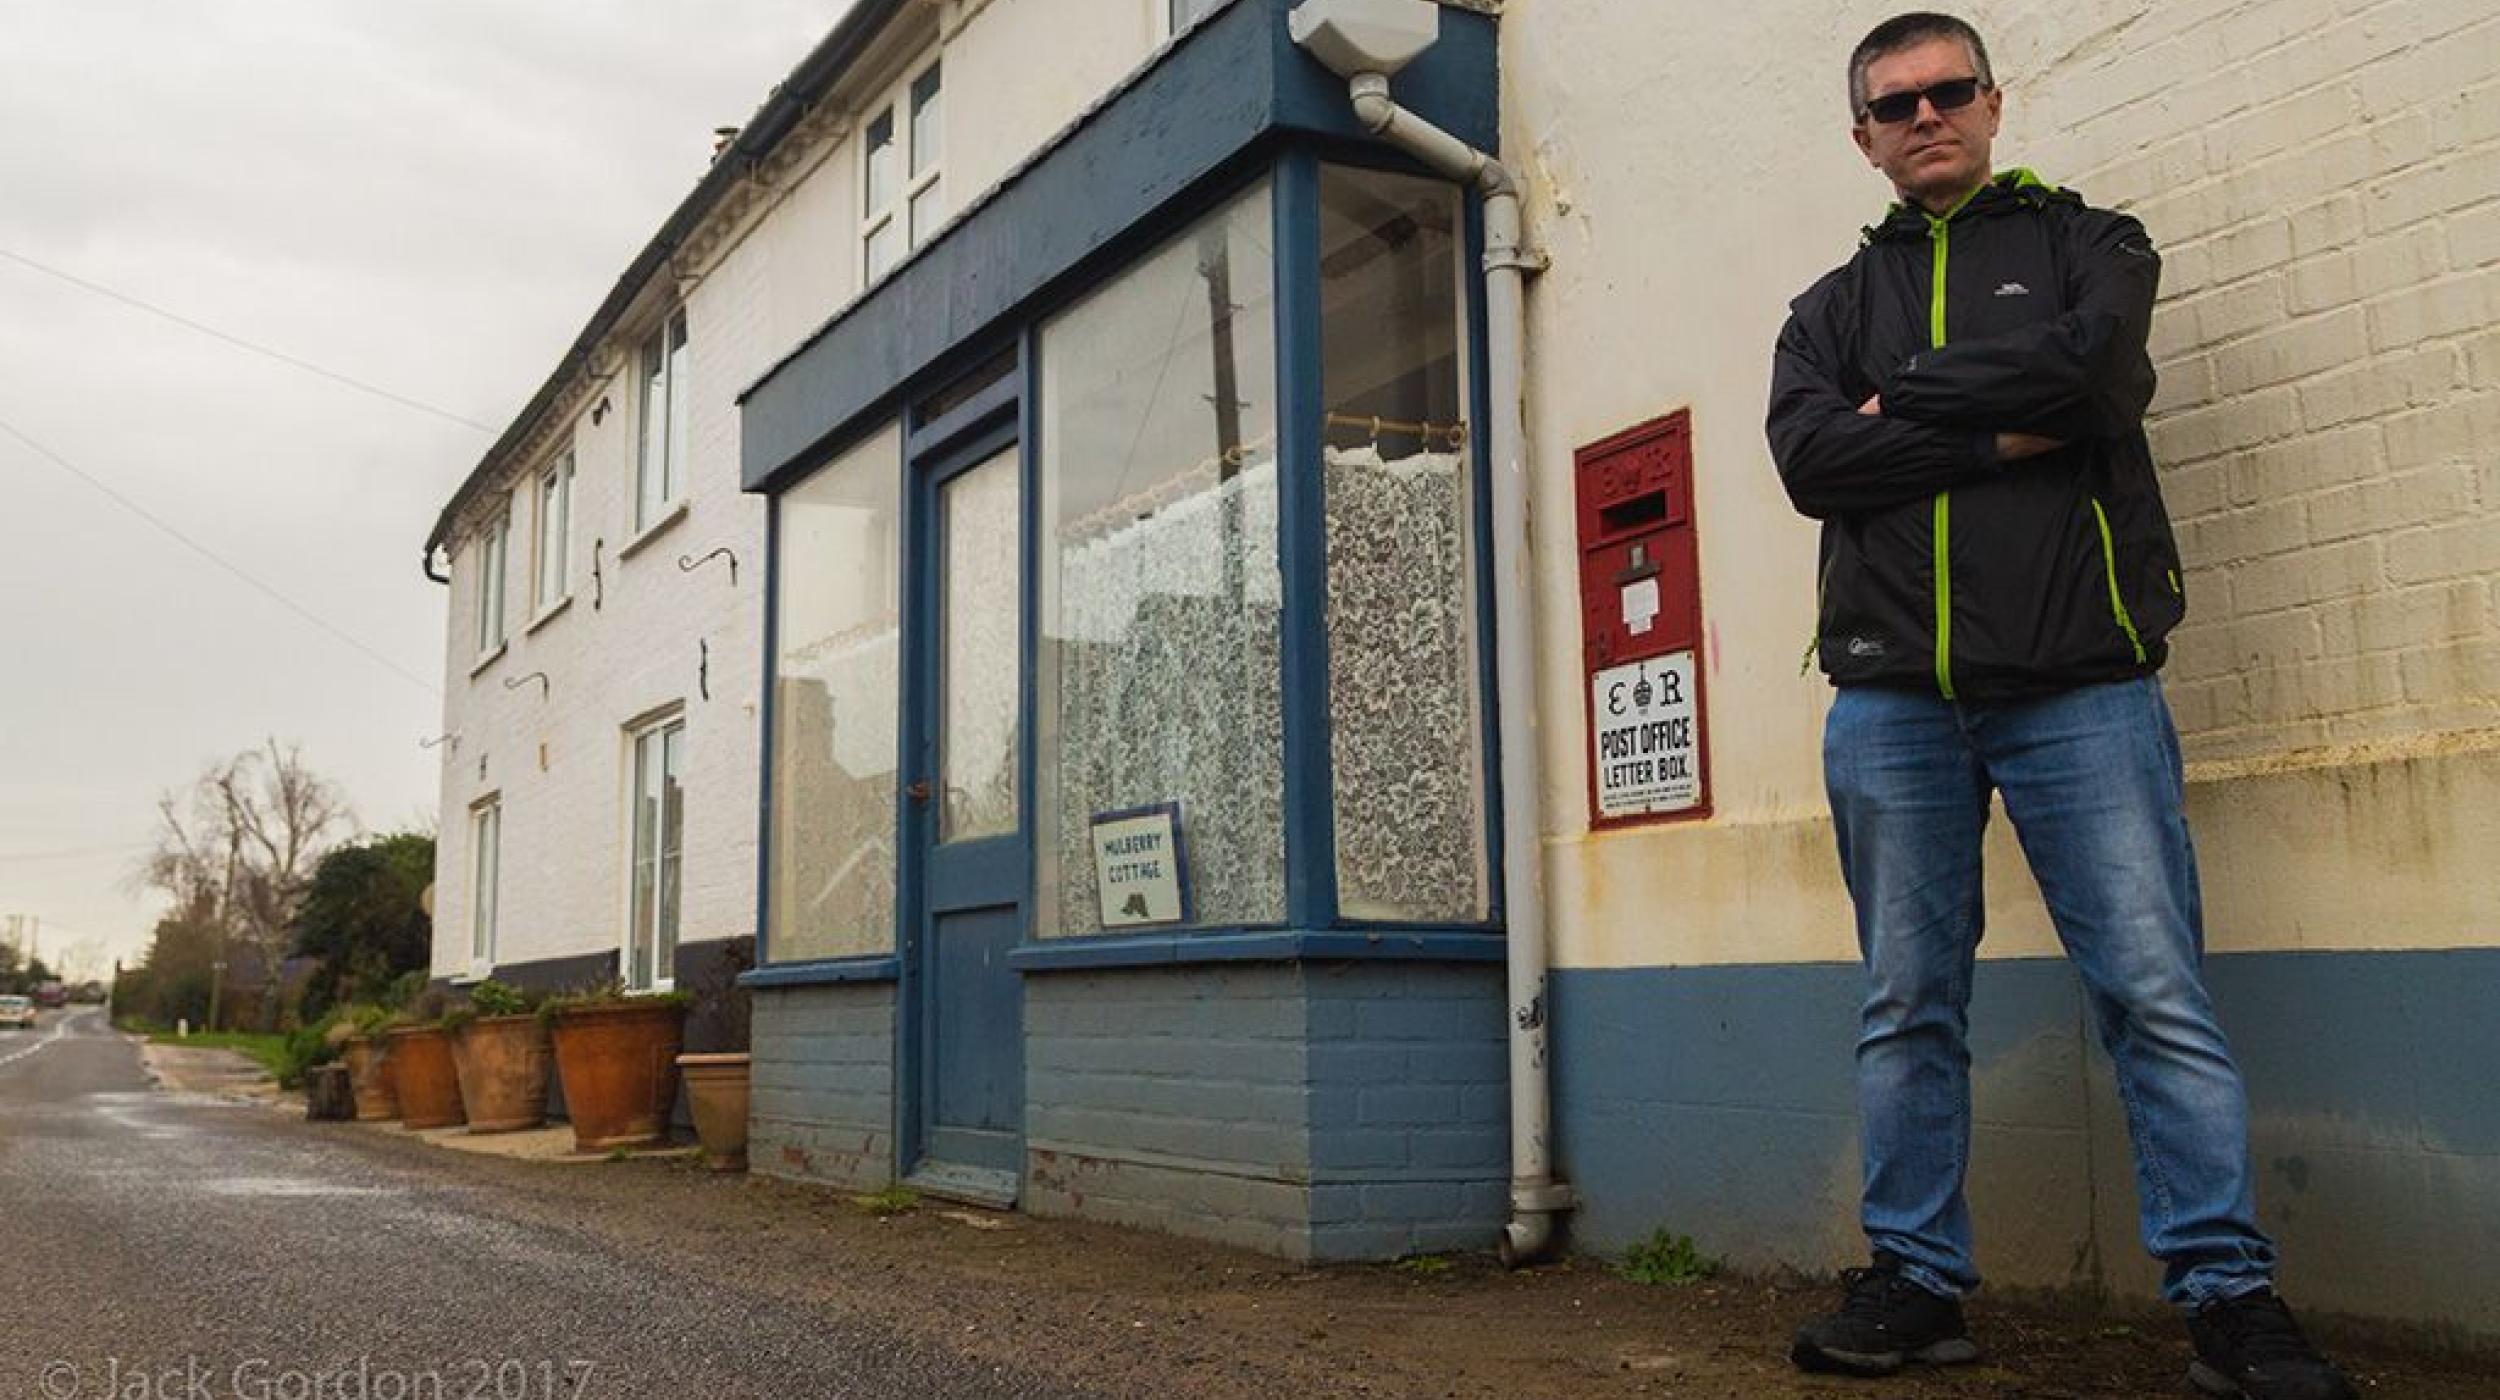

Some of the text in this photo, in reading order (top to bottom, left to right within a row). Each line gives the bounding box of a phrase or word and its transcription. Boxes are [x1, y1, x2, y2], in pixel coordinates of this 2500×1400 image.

[1659, 669, 1683, 707] R
[1601, 715, 1691, 760] POST OFFICE
[1604, 760, 1654, 788] LETTER
[1104, 832, 1162, 855] MULBERRY
[1109, 859, 1162, 883] COTTAGE
